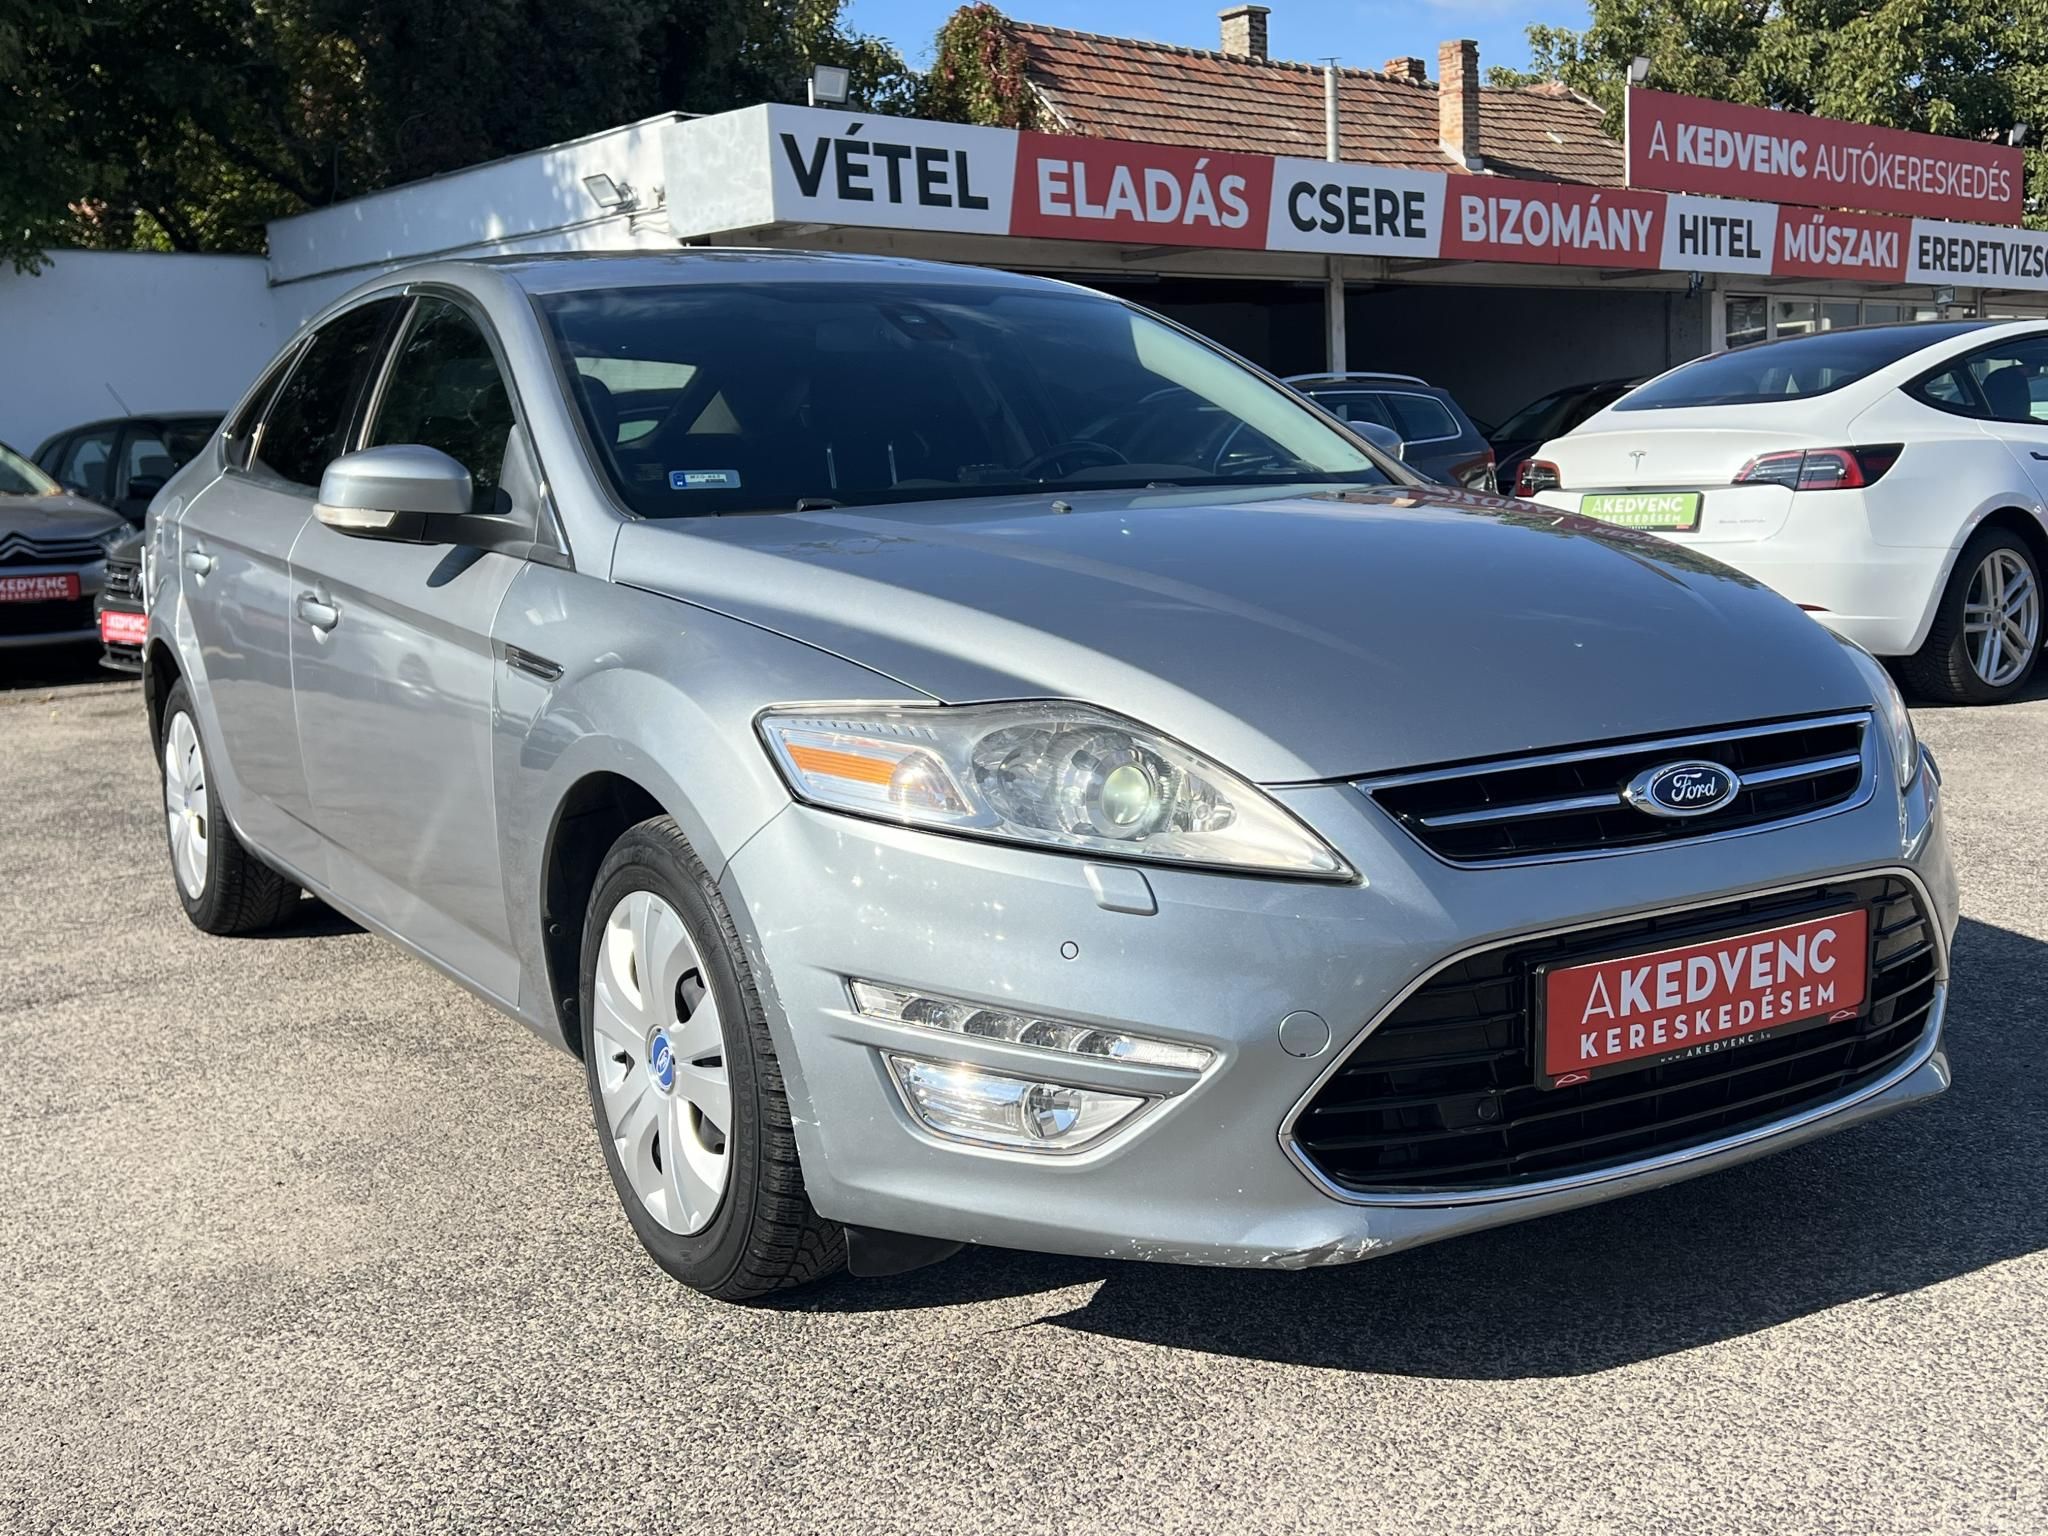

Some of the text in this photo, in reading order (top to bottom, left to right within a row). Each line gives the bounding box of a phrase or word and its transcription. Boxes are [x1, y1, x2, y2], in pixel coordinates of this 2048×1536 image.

[779, 122, 990, 211] VÉTEL
[1648, 120, 2011, 203] A KEDVENC AUTÓKERESKEDÉS
[1036, 157, 1250, 229] ELADÁS
[1287, 181, 1425, 239] CSERE
[1459, 193, 1653, 252] BIZOMÁNY
[1679, 212, 1762, 259] HITEL
[1784, 210, 1900, 269] MŰSZAKI
[1671, 772, 1717, 802] Ford
[1580, 980, 1835, 1060] KERESKEDÉSEM
